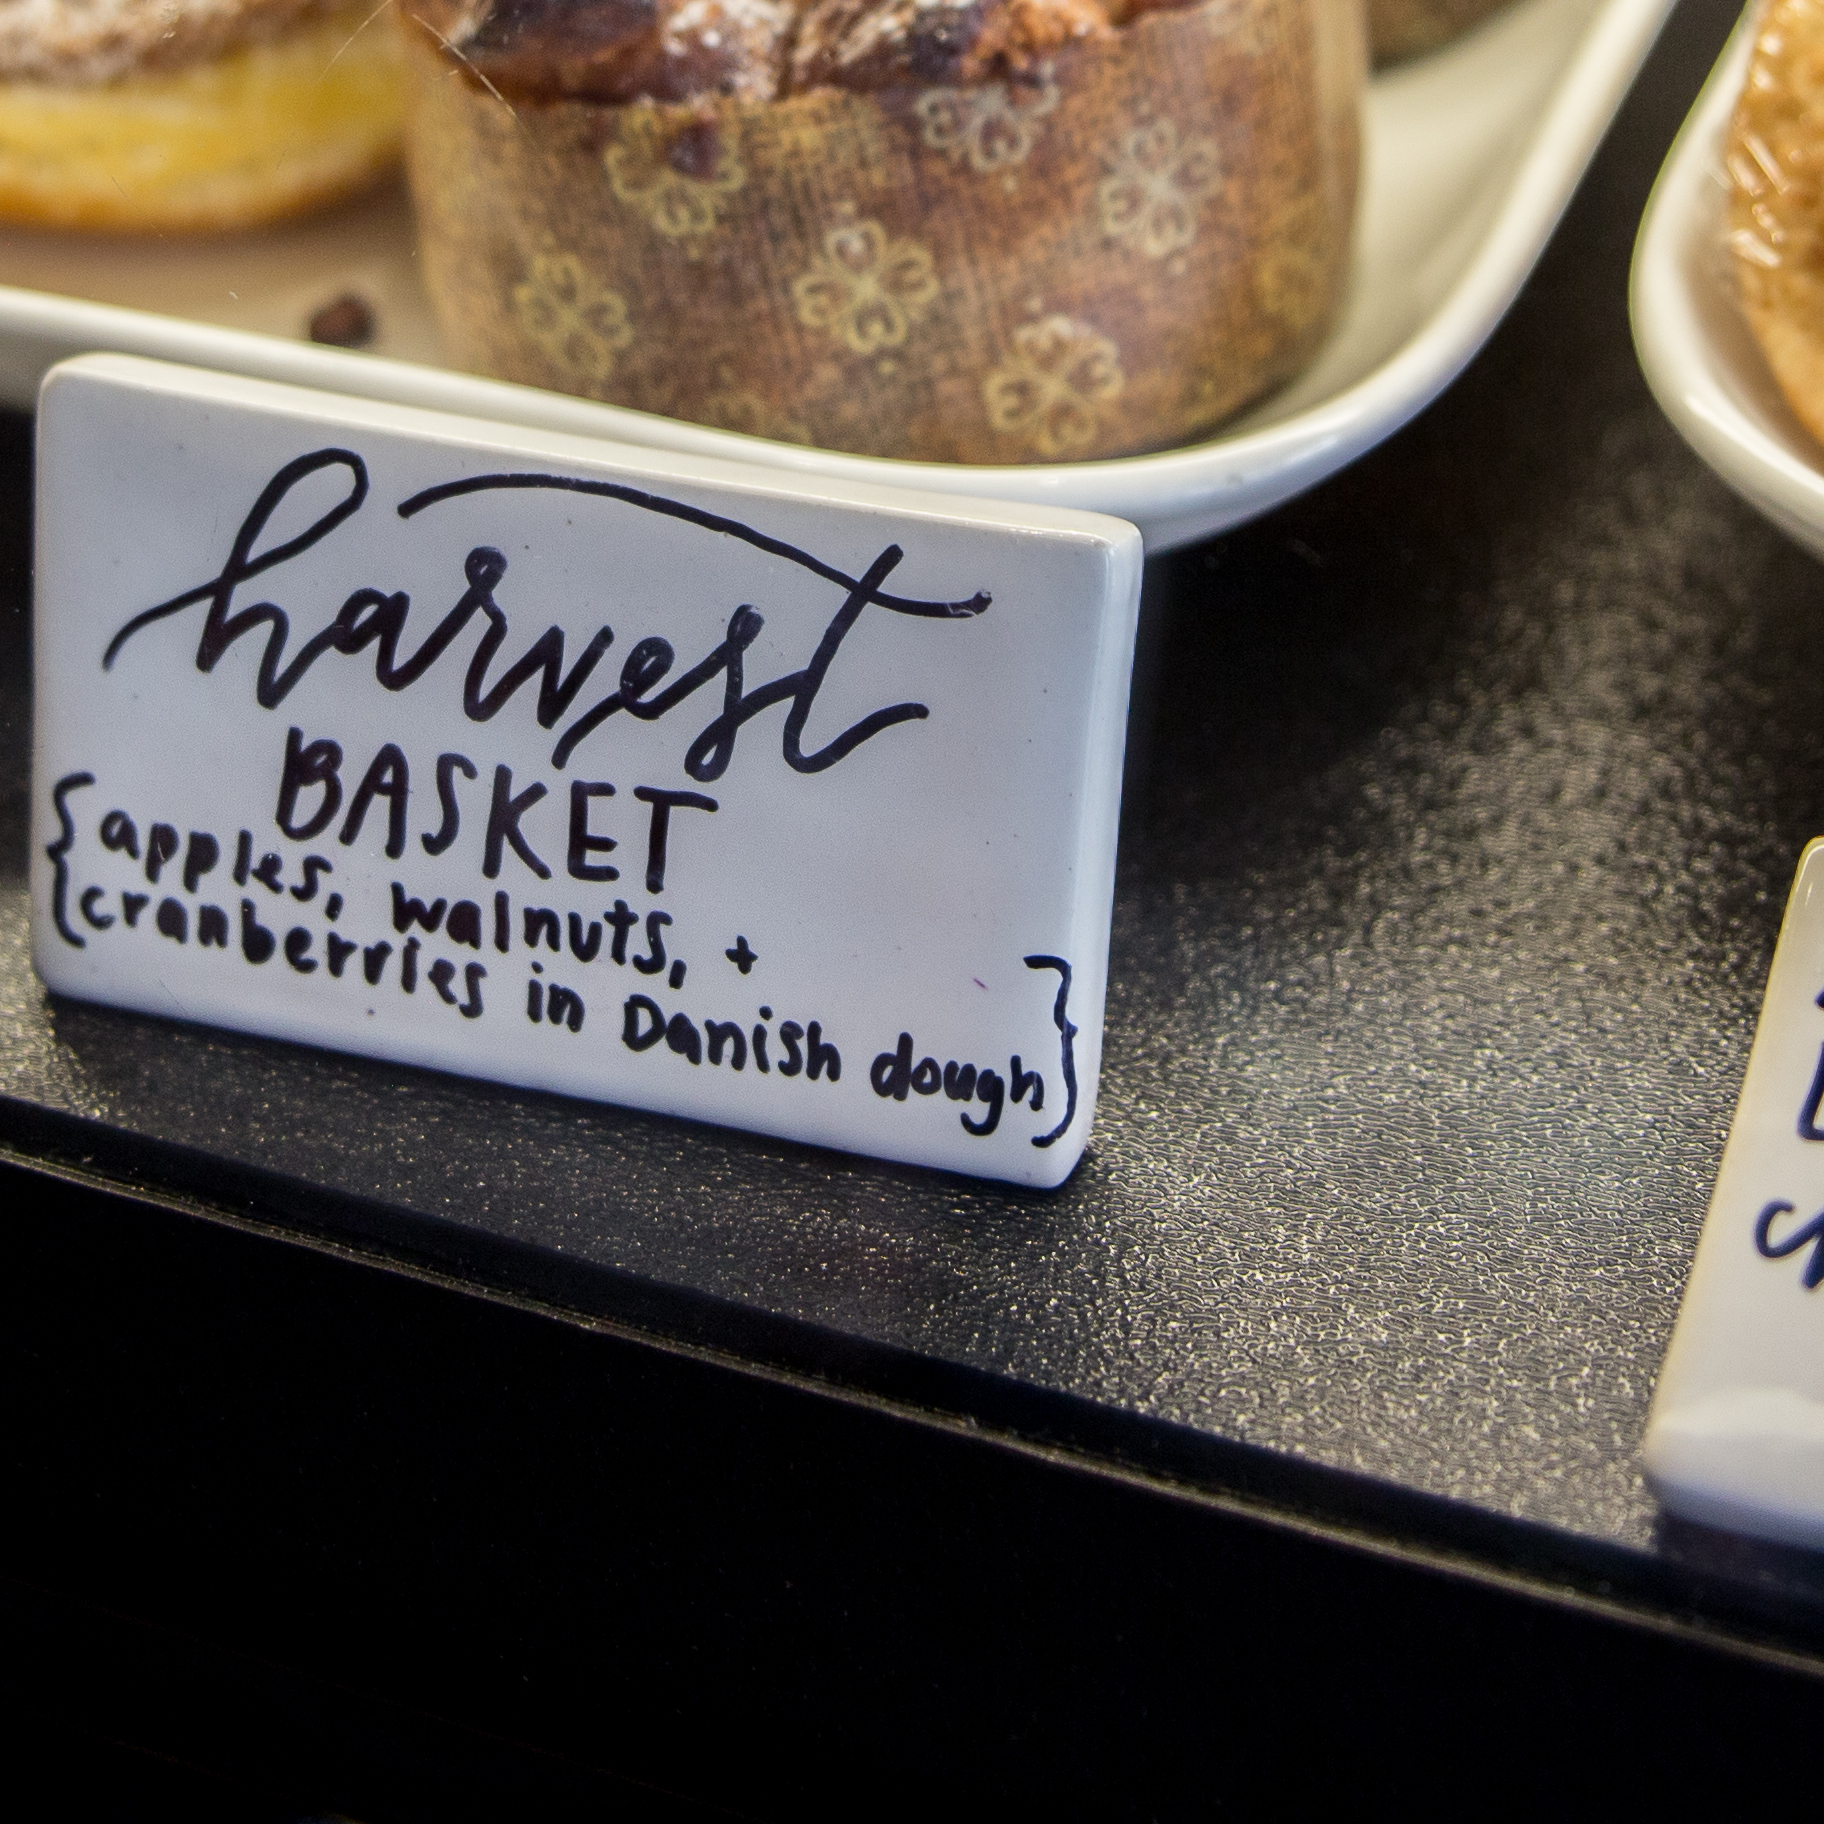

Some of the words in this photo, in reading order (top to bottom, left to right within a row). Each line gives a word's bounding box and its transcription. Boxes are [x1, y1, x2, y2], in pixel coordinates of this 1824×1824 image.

[102, 447, 993, 778] harvest
[275, 726, 719, 895] BASKET
[79, 884, 487, 1020] cranberries
[526, 961, 586, 1034] in
[621, 994, 842, 1083] Danish
[390, 881, 688, 991] walnuts,
